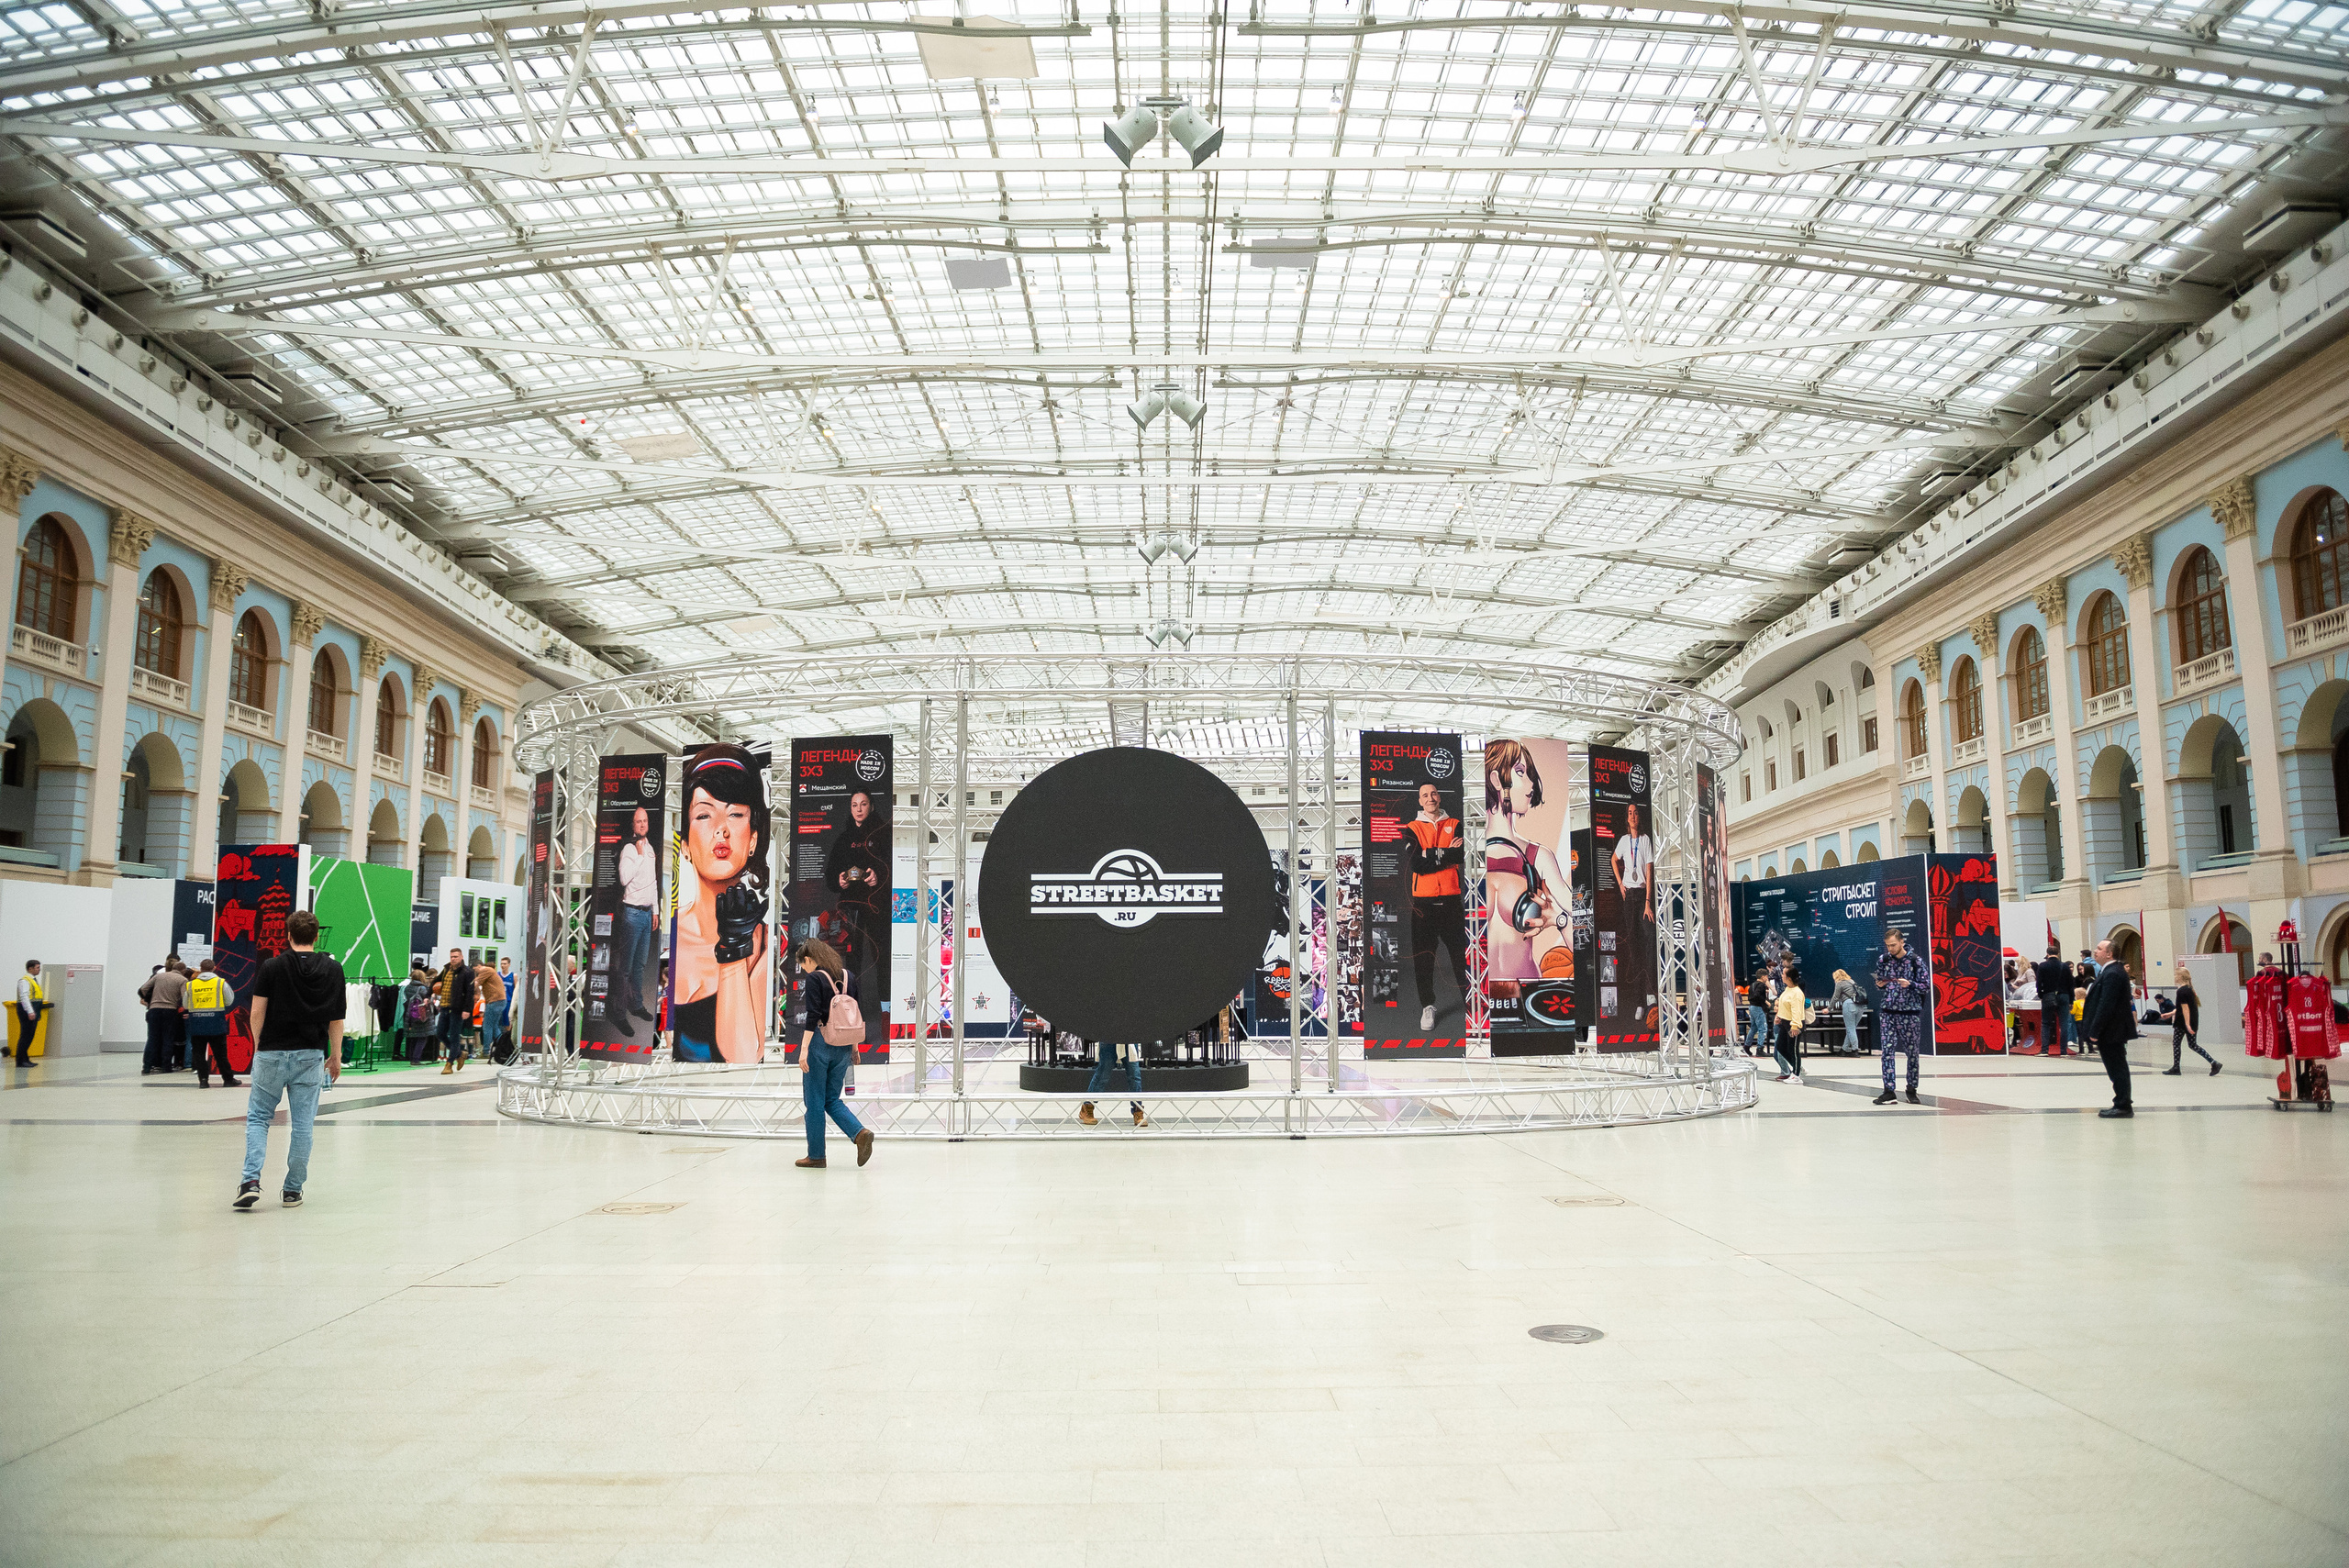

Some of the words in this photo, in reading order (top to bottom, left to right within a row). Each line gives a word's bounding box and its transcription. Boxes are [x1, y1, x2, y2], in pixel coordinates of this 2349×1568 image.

[800, 749, 861, 763] ЛЕГЕНДЫ
[1369, 744, 1431, 760] ЛЕГЕНДЫ
[604, 767, 646, 780] ЛЕГЕНДЫ
[1595, 758, 1632, 774] ЛЕГЕНДЫ
[1030, 884, 1223, 903] STREETBASKET
[1822, 882, 1876, 903] СТРИТБАСКЕТ
[1114, 912, 1136, 921] .RU
[1845, 901, 1877, 919] СТРОИТ
